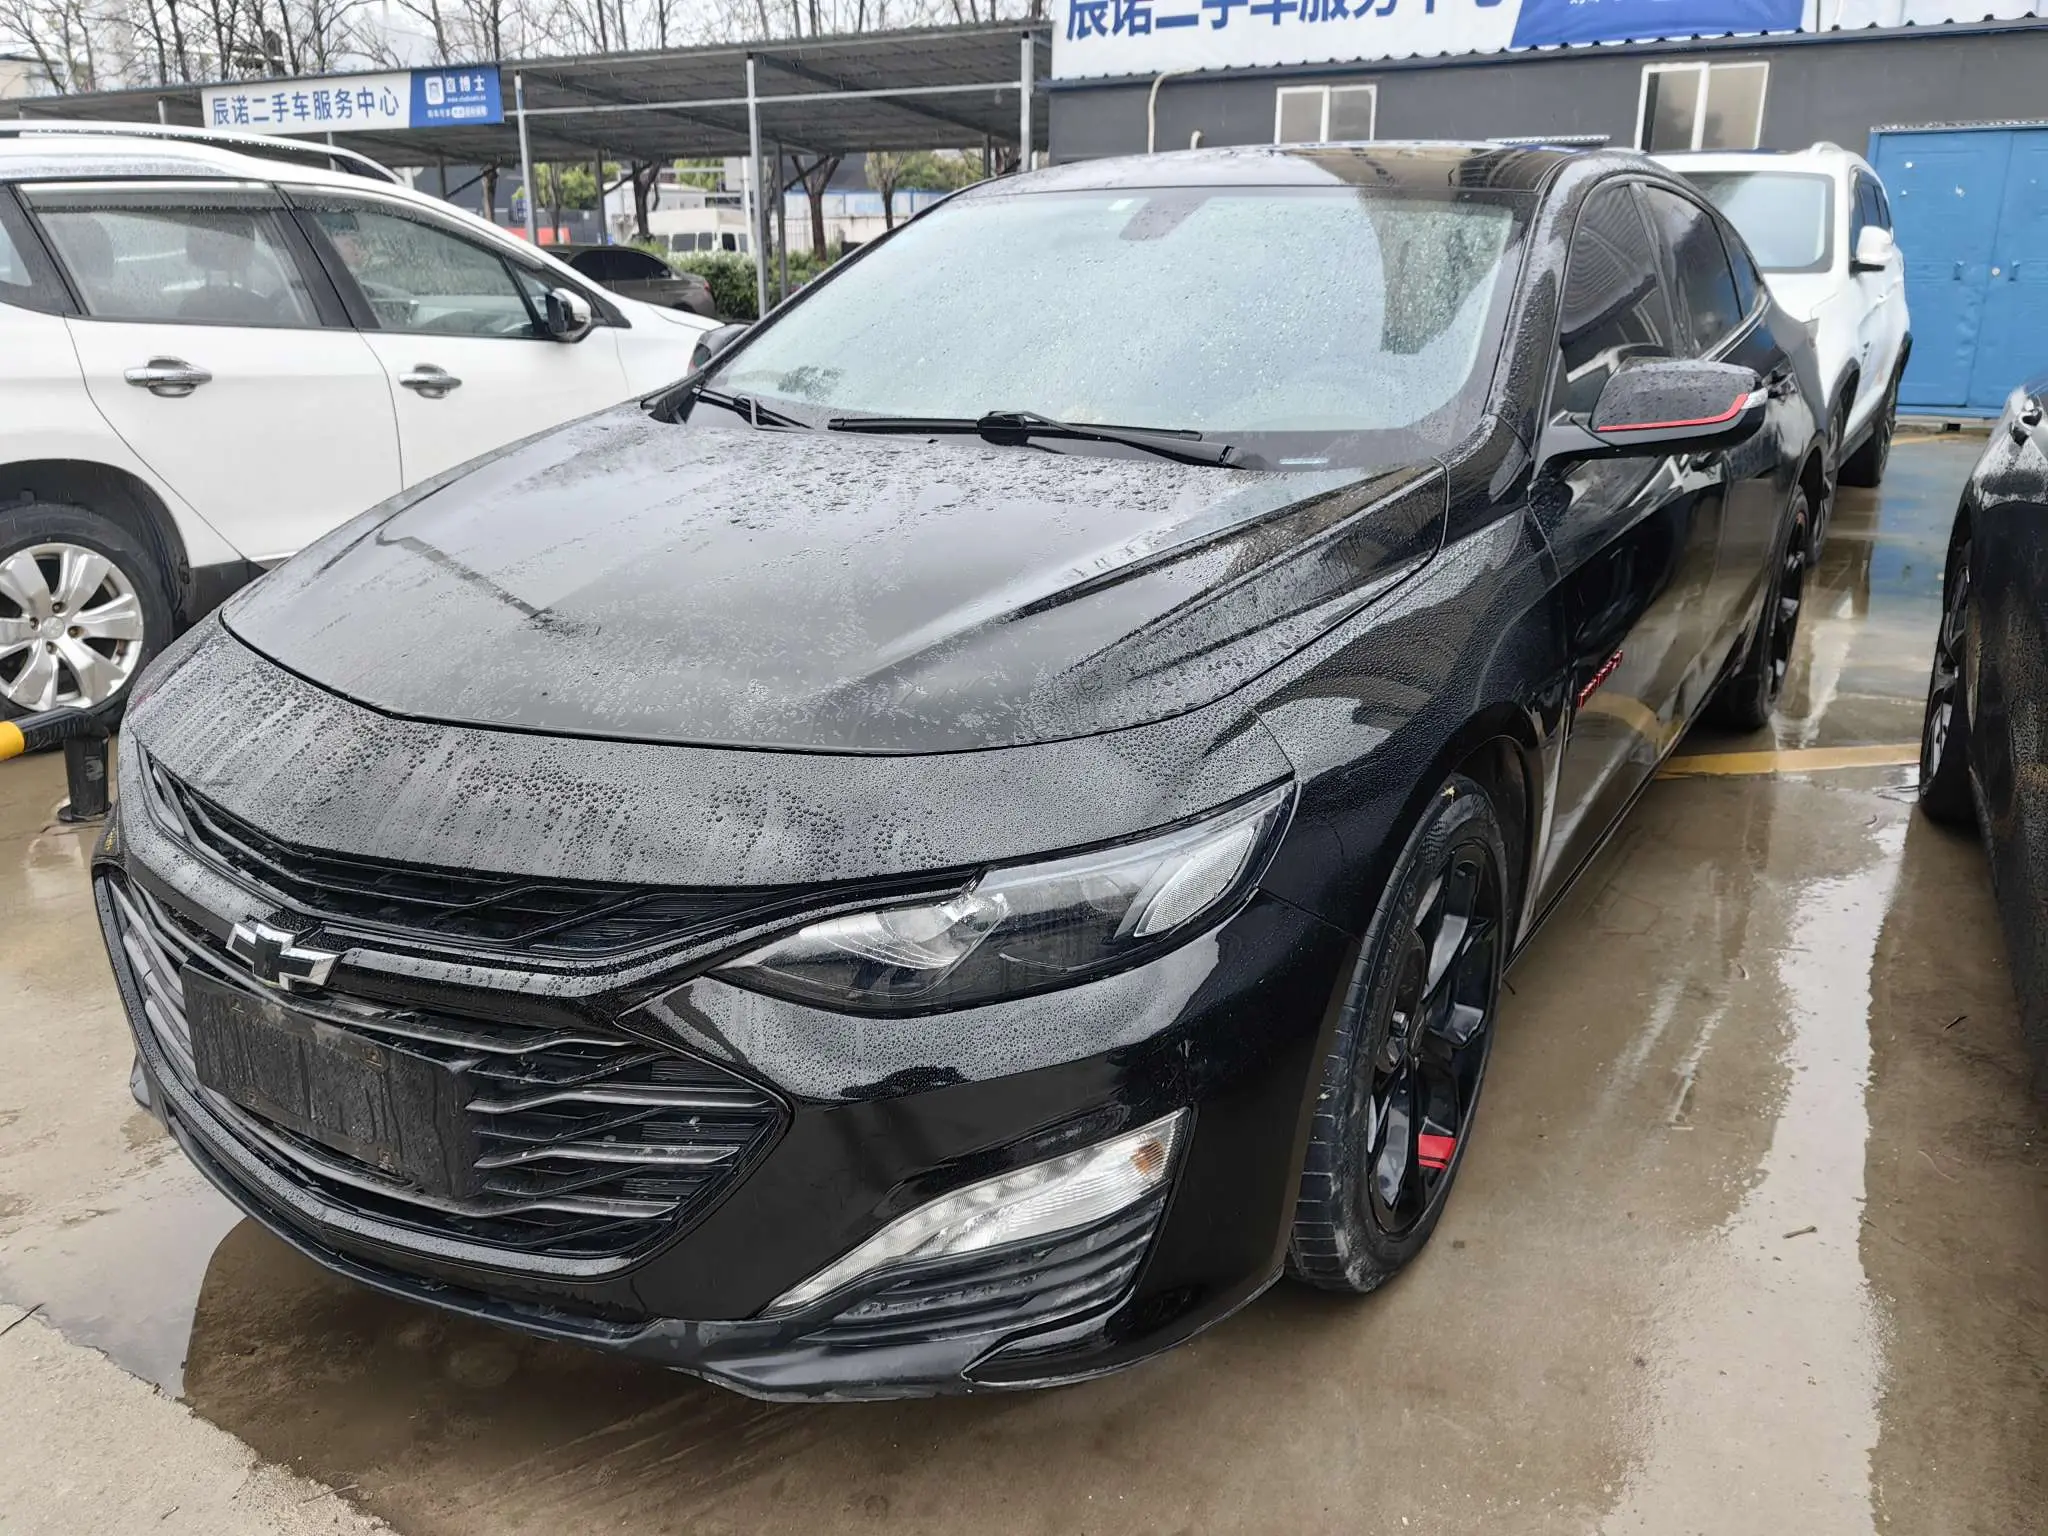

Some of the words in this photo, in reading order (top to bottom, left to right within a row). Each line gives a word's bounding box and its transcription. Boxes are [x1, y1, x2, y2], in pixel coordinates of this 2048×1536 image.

[212, 86, 400, 126] 辰诺二手车服务中心
